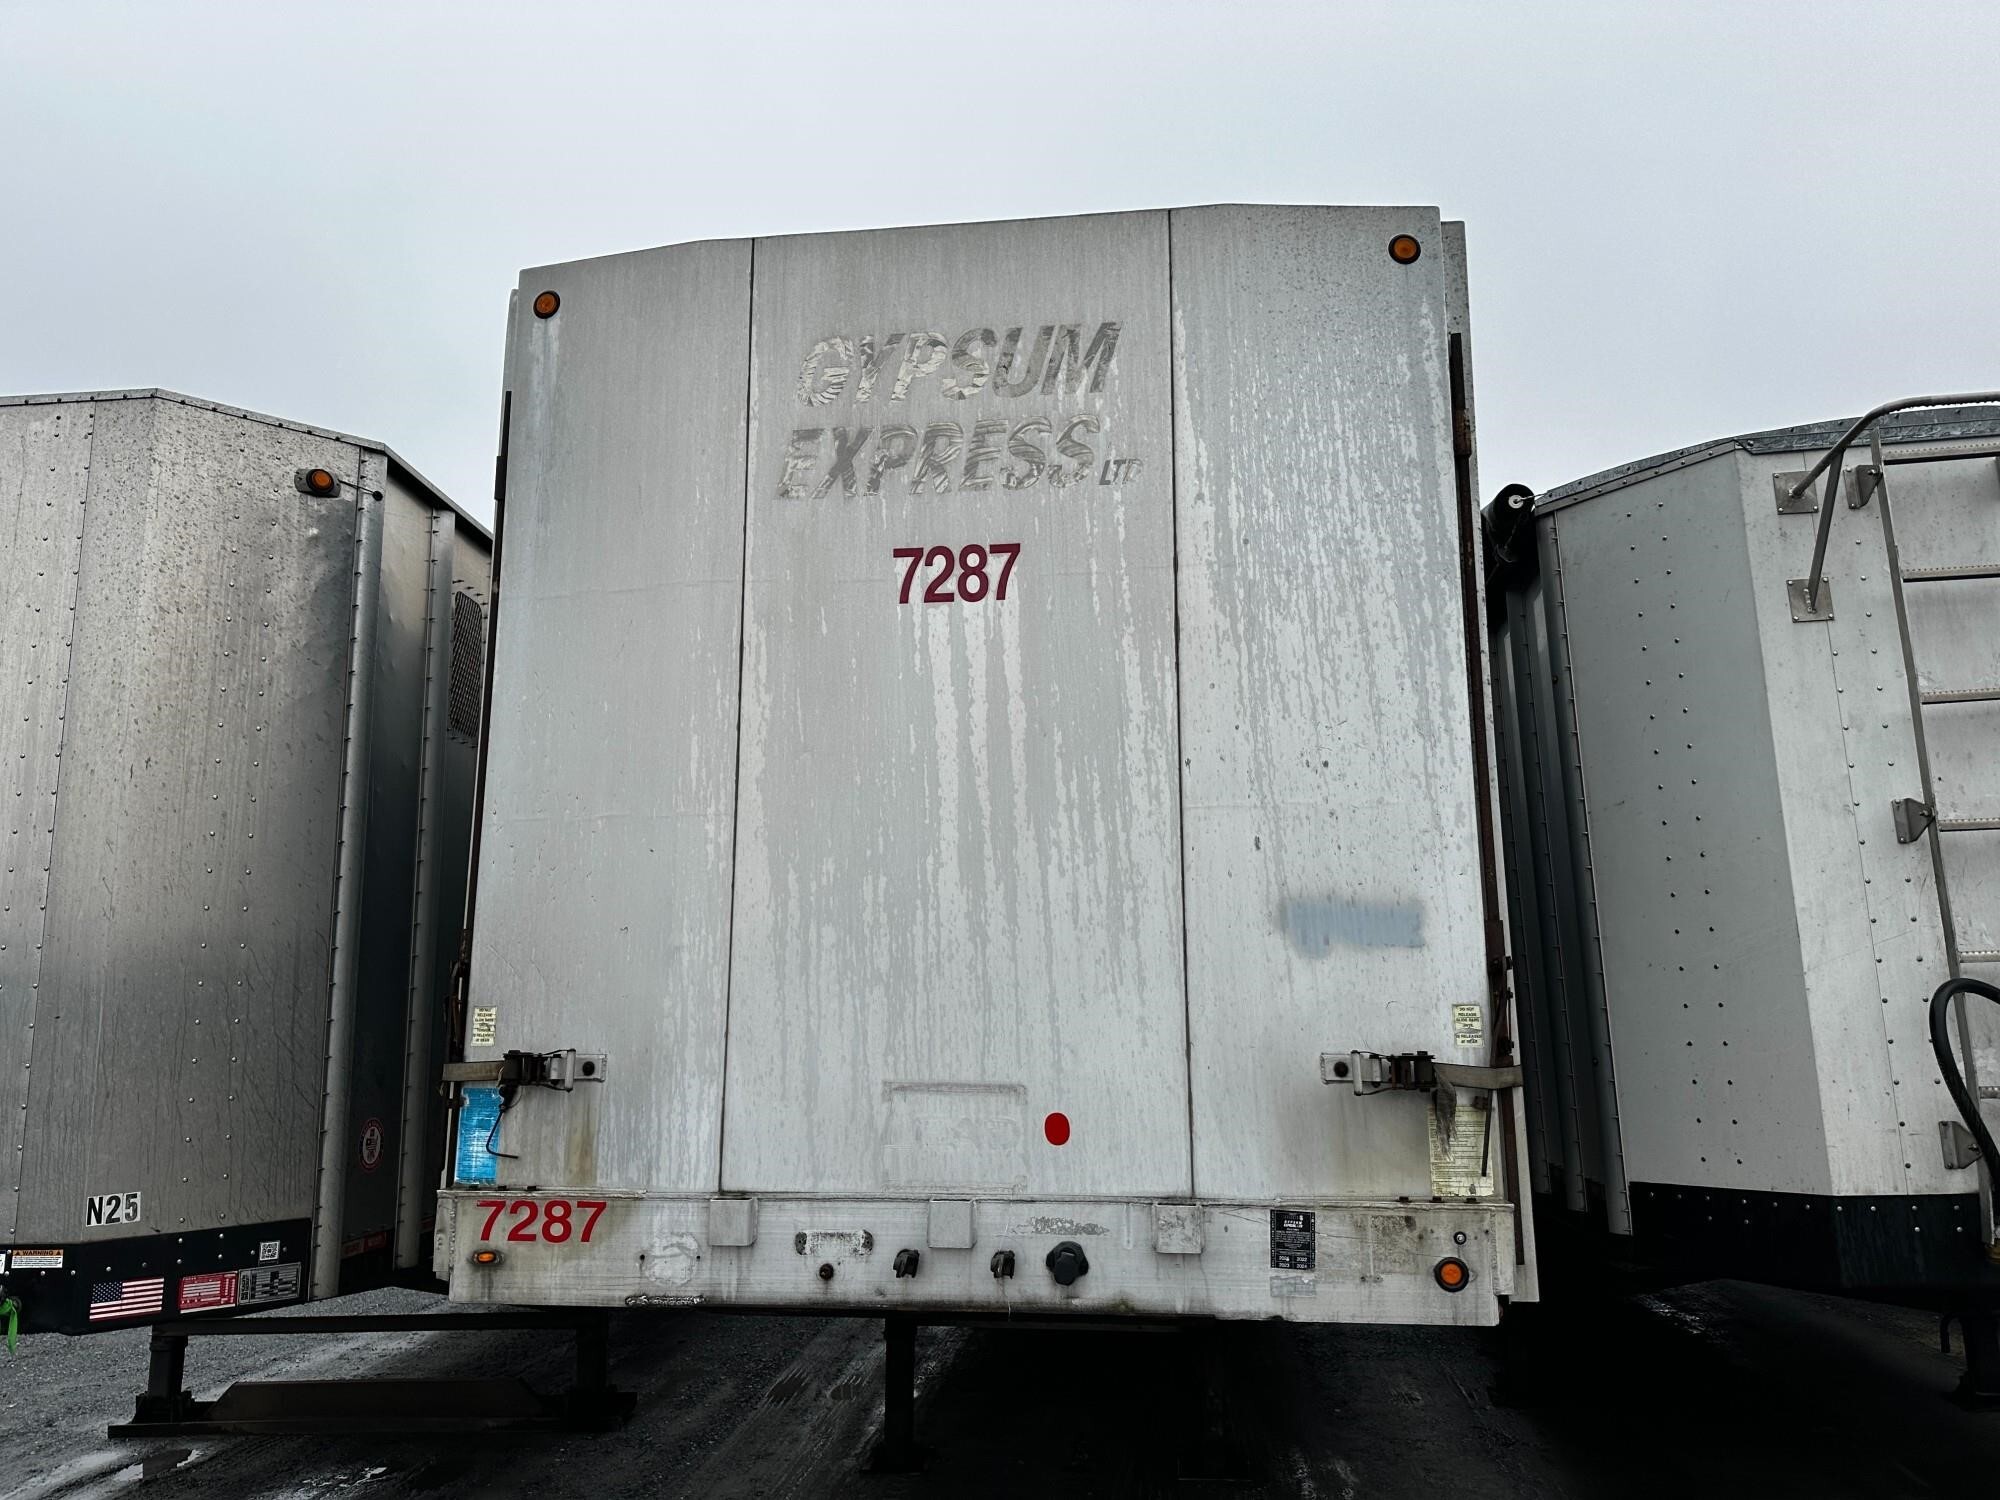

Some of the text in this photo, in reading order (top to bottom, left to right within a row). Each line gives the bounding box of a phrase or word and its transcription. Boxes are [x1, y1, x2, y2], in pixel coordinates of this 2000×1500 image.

[798, 322, 1122, 406] GYPSUM
[777, 413, 1100, 499] EXPRESS
[893, 543, 1021, 604] 7287
[87, 1193, 138, 1225] N25
[477, 1200, 607, 1243] 7287
